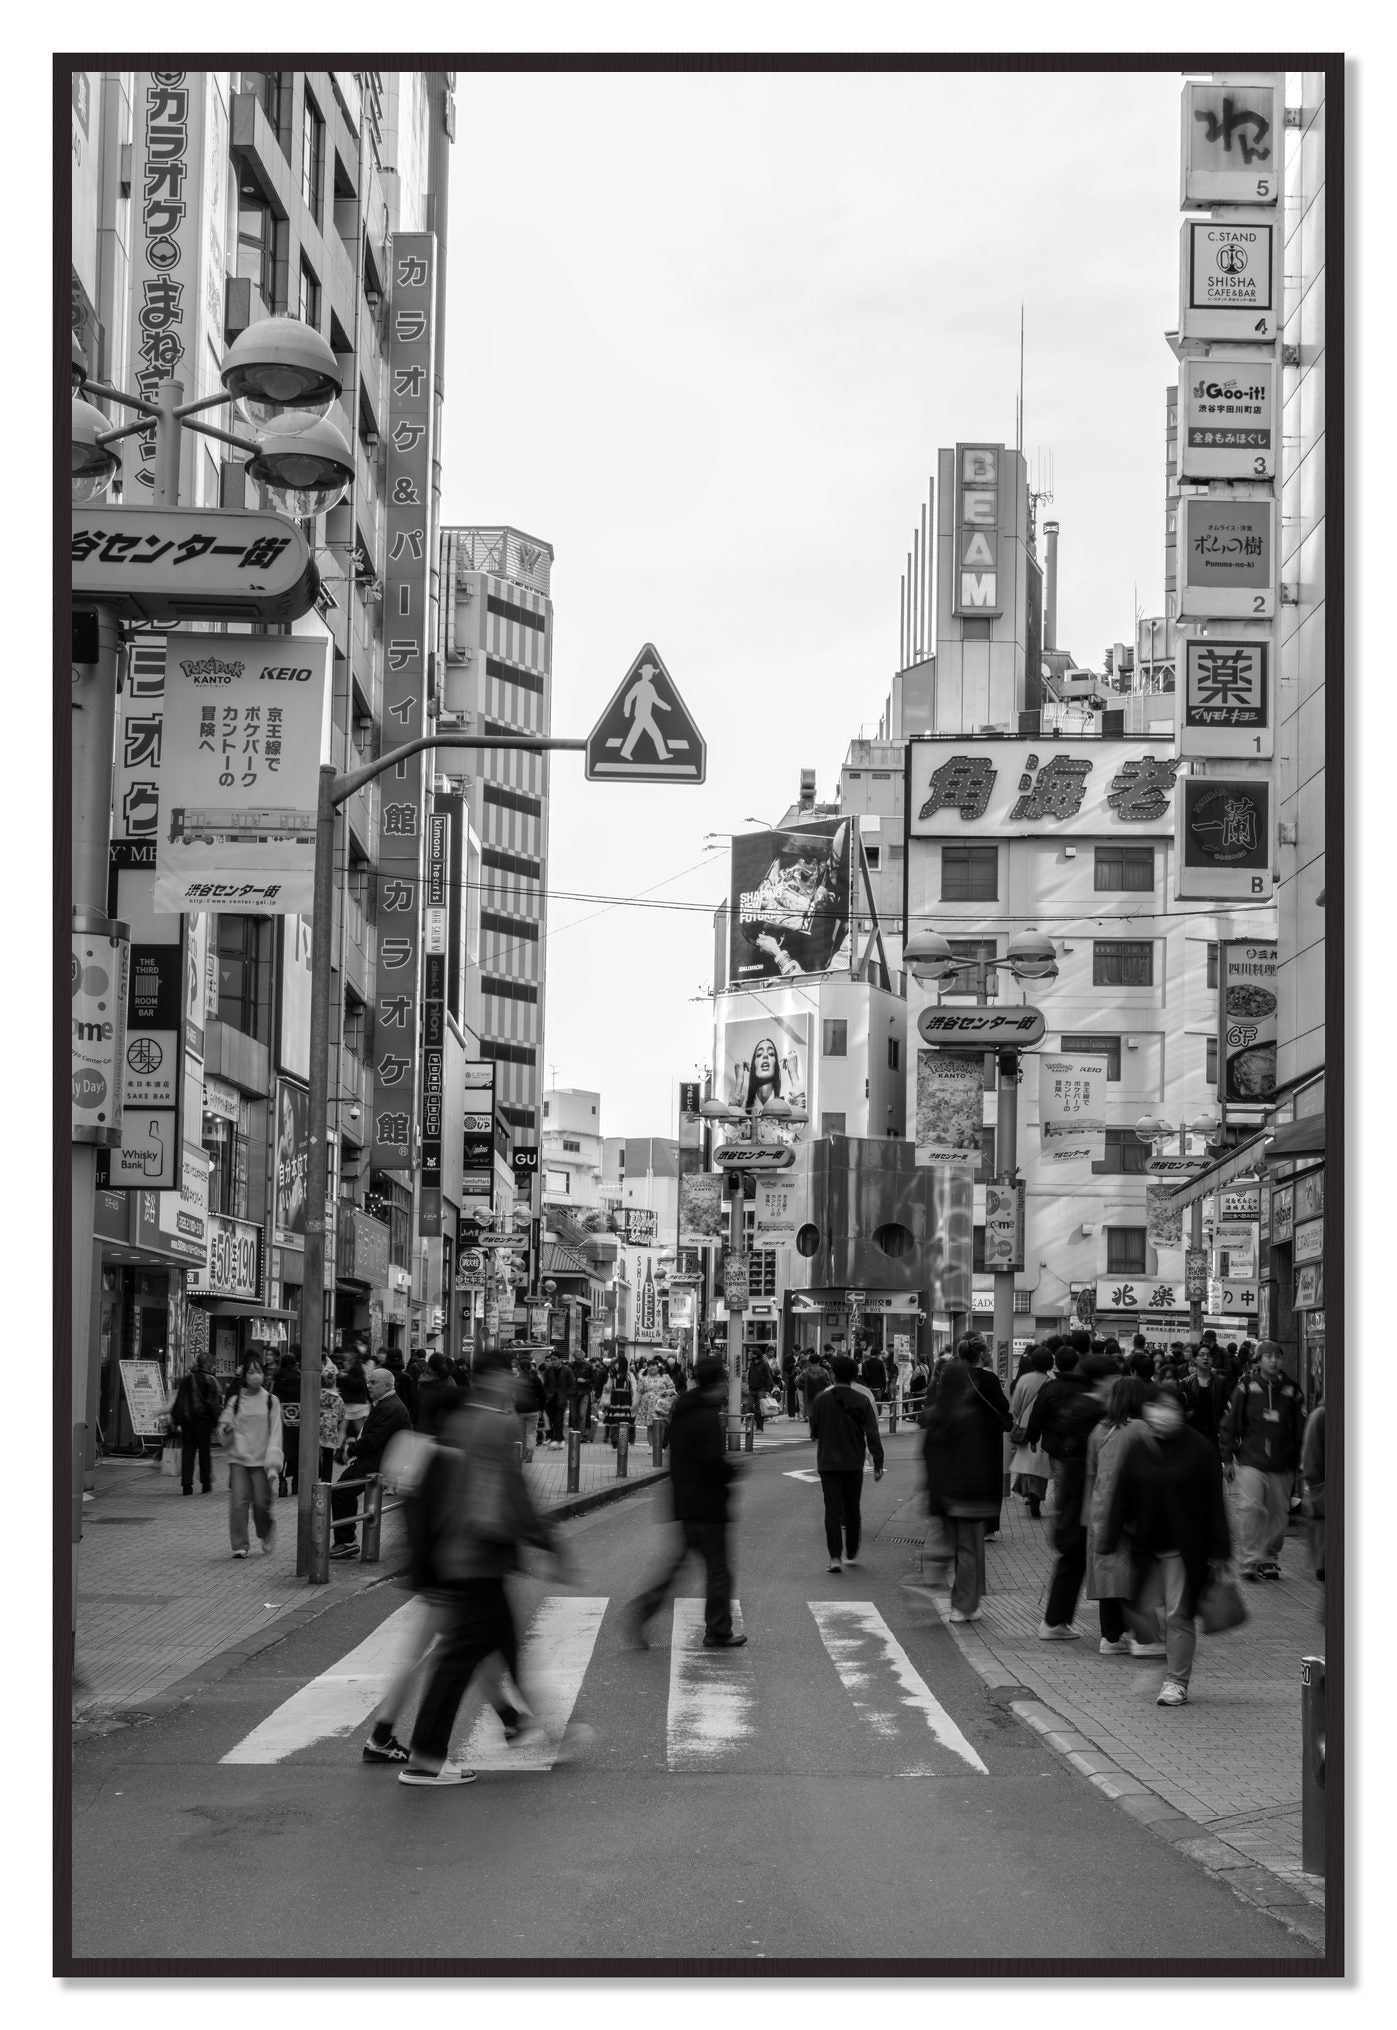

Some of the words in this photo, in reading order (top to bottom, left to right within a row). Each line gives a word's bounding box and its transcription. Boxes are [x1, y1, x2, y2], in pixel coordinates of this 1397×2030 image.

[143, 87, 188, 238] カラオケ
[1256, 180, 1270, 197] 5
[1207, 231, 1257, 242] C.STAND
[1207, 276, 1256, 288] SHISHA
[1207, 288, 1256, 297] CAFE&BAR
[1254, 318, 1268, 335] 4
[1206, 383, 1265, 400] Goo-it!
[1198, 404, 1262, 415] 渋谷宇田川町店
[1193, 431, 1266, 444] 全身もみほぐし
[1254, 457, 1267, 474] 3
[961, 448, 998, 607] BEAM
[72, 531, 292, 569] 谷センター街
[1193, 534, 1264, 556] ポムの樹
[1205, 560, 1255, 568] Pomme-no-ki
[1253, 596, 1266, 613] 2
[193, 676, 231, 684] KANTO
[259, 666, 312, 682] KEIO
[1197, 649, 1252, 704] 薬
[1191, 707, 1258, 724] マツモトキヨシ
[198, 706, 216, 752] 冒険へ
[219, 706, 238, 787] カントーの
[241, 706, 261, 787] ポケパーク
[264, 707, 283, 772] 京王線で
[1252, 736, 1261, 753] 1
[918, 754, 1180, 821] 角海老
[1192, 797, 1257, 849] 一蘭
[432, 819, 442, 858] kimono
[431, 864, 442, 901] hearts
[1251, 876, 1264, 894] B
[184, 883, 282, 898] 渋谷センター街
[739, 889, 782, 903] SHAPING
[431, 910, 442, 923] HAIR
[139, 958, 156, 966] THE
[738, 964, 764, 973] SALOMON
[1229, 962, 1277, 976] 四川料理
[135, 966, 159, 974] THIRD
[135, 997, 158, 1005] ROOM
[138, 1009, 154, 1017] BAR
[925, 1016, 1039, 1031] 渋谷センター街
[1227, 1025, 1258, 1047] 6F
[83, 1079, 105, 1094] Day!
[477, 1121, 490, 1130] UP
[122, 1149, 158, 1162] Whisky
[515, 1153, 537, 1165] GU
[717, 1149, 786, 1161] 渋谷センター街
[928, 1152, 968, 1160] 渋谷センター街
[1052, 1149, 1091, 1159] 渋谷センター街
[121, 1160, 143, 1169] Bank
[1149, 1161, 1211, 1170] 渋谷センター街
[96, 1171, 108, 1183] 1F
[216, 1232, 231, 1286] 50
[236, 1237, 255, 1289] 190
[462, 1258, 480, 1267] 消火栓
[1111, 1283, 1176, 1308] 兆楽
[644, 1282, 654, 1328] BEER
[641, 1330, 655, 1338] HALL
